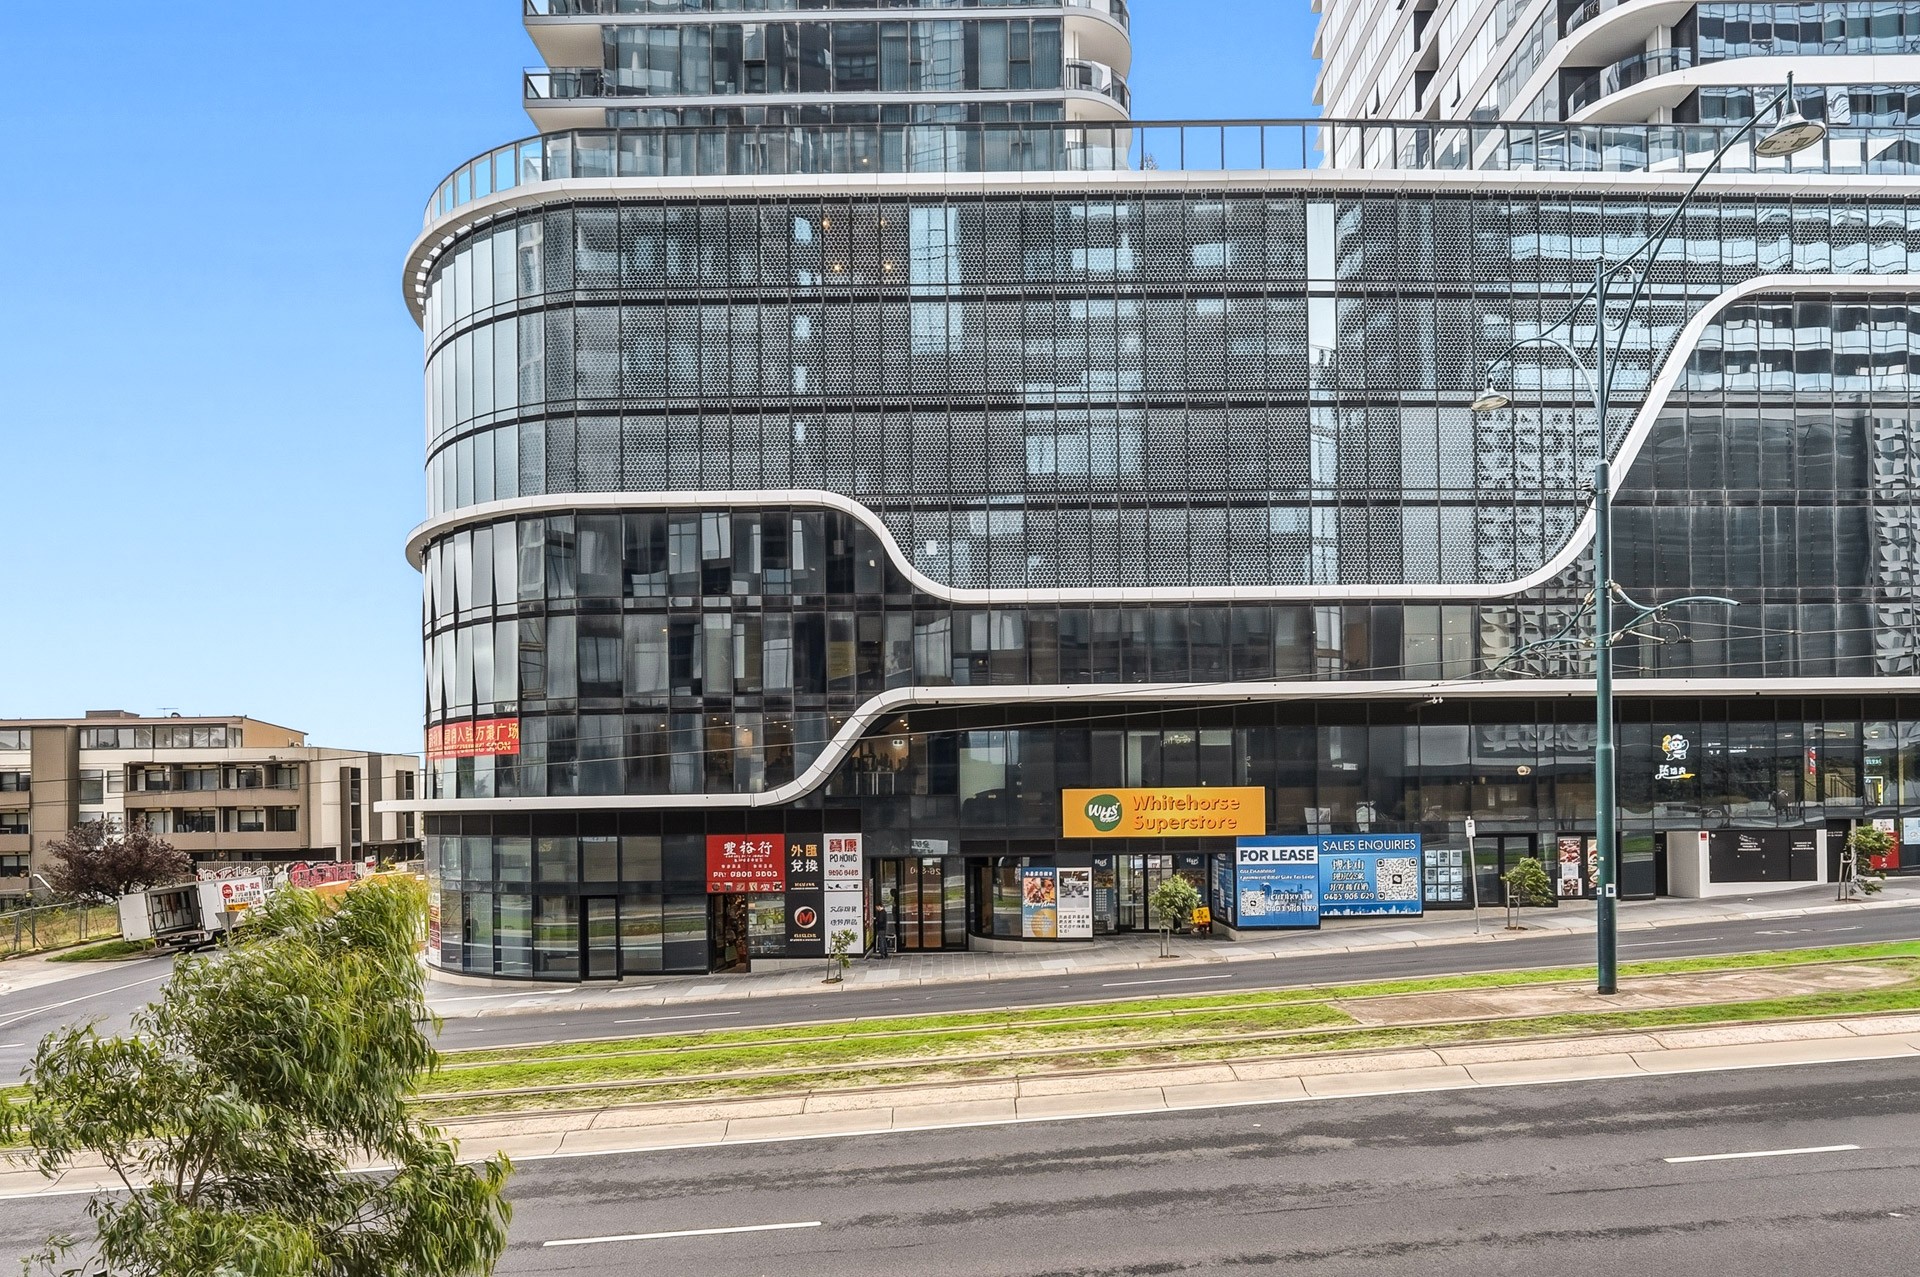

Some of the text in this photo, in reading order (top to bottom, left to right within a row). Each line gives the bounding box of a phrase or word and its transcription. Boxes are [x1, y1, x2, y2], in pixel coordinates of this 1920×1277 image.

[1134, 794, 1240, 811] Whitehorse
[1134, 815, 1237, 833] Superstore
[791, 844, 818, 857] 外匯
[1322, 839, 1416, 851] SALES ENQUIRIES
[829, 854, 838, 862] PO
[1240, 849, 1315, 862] FOR LEASE
